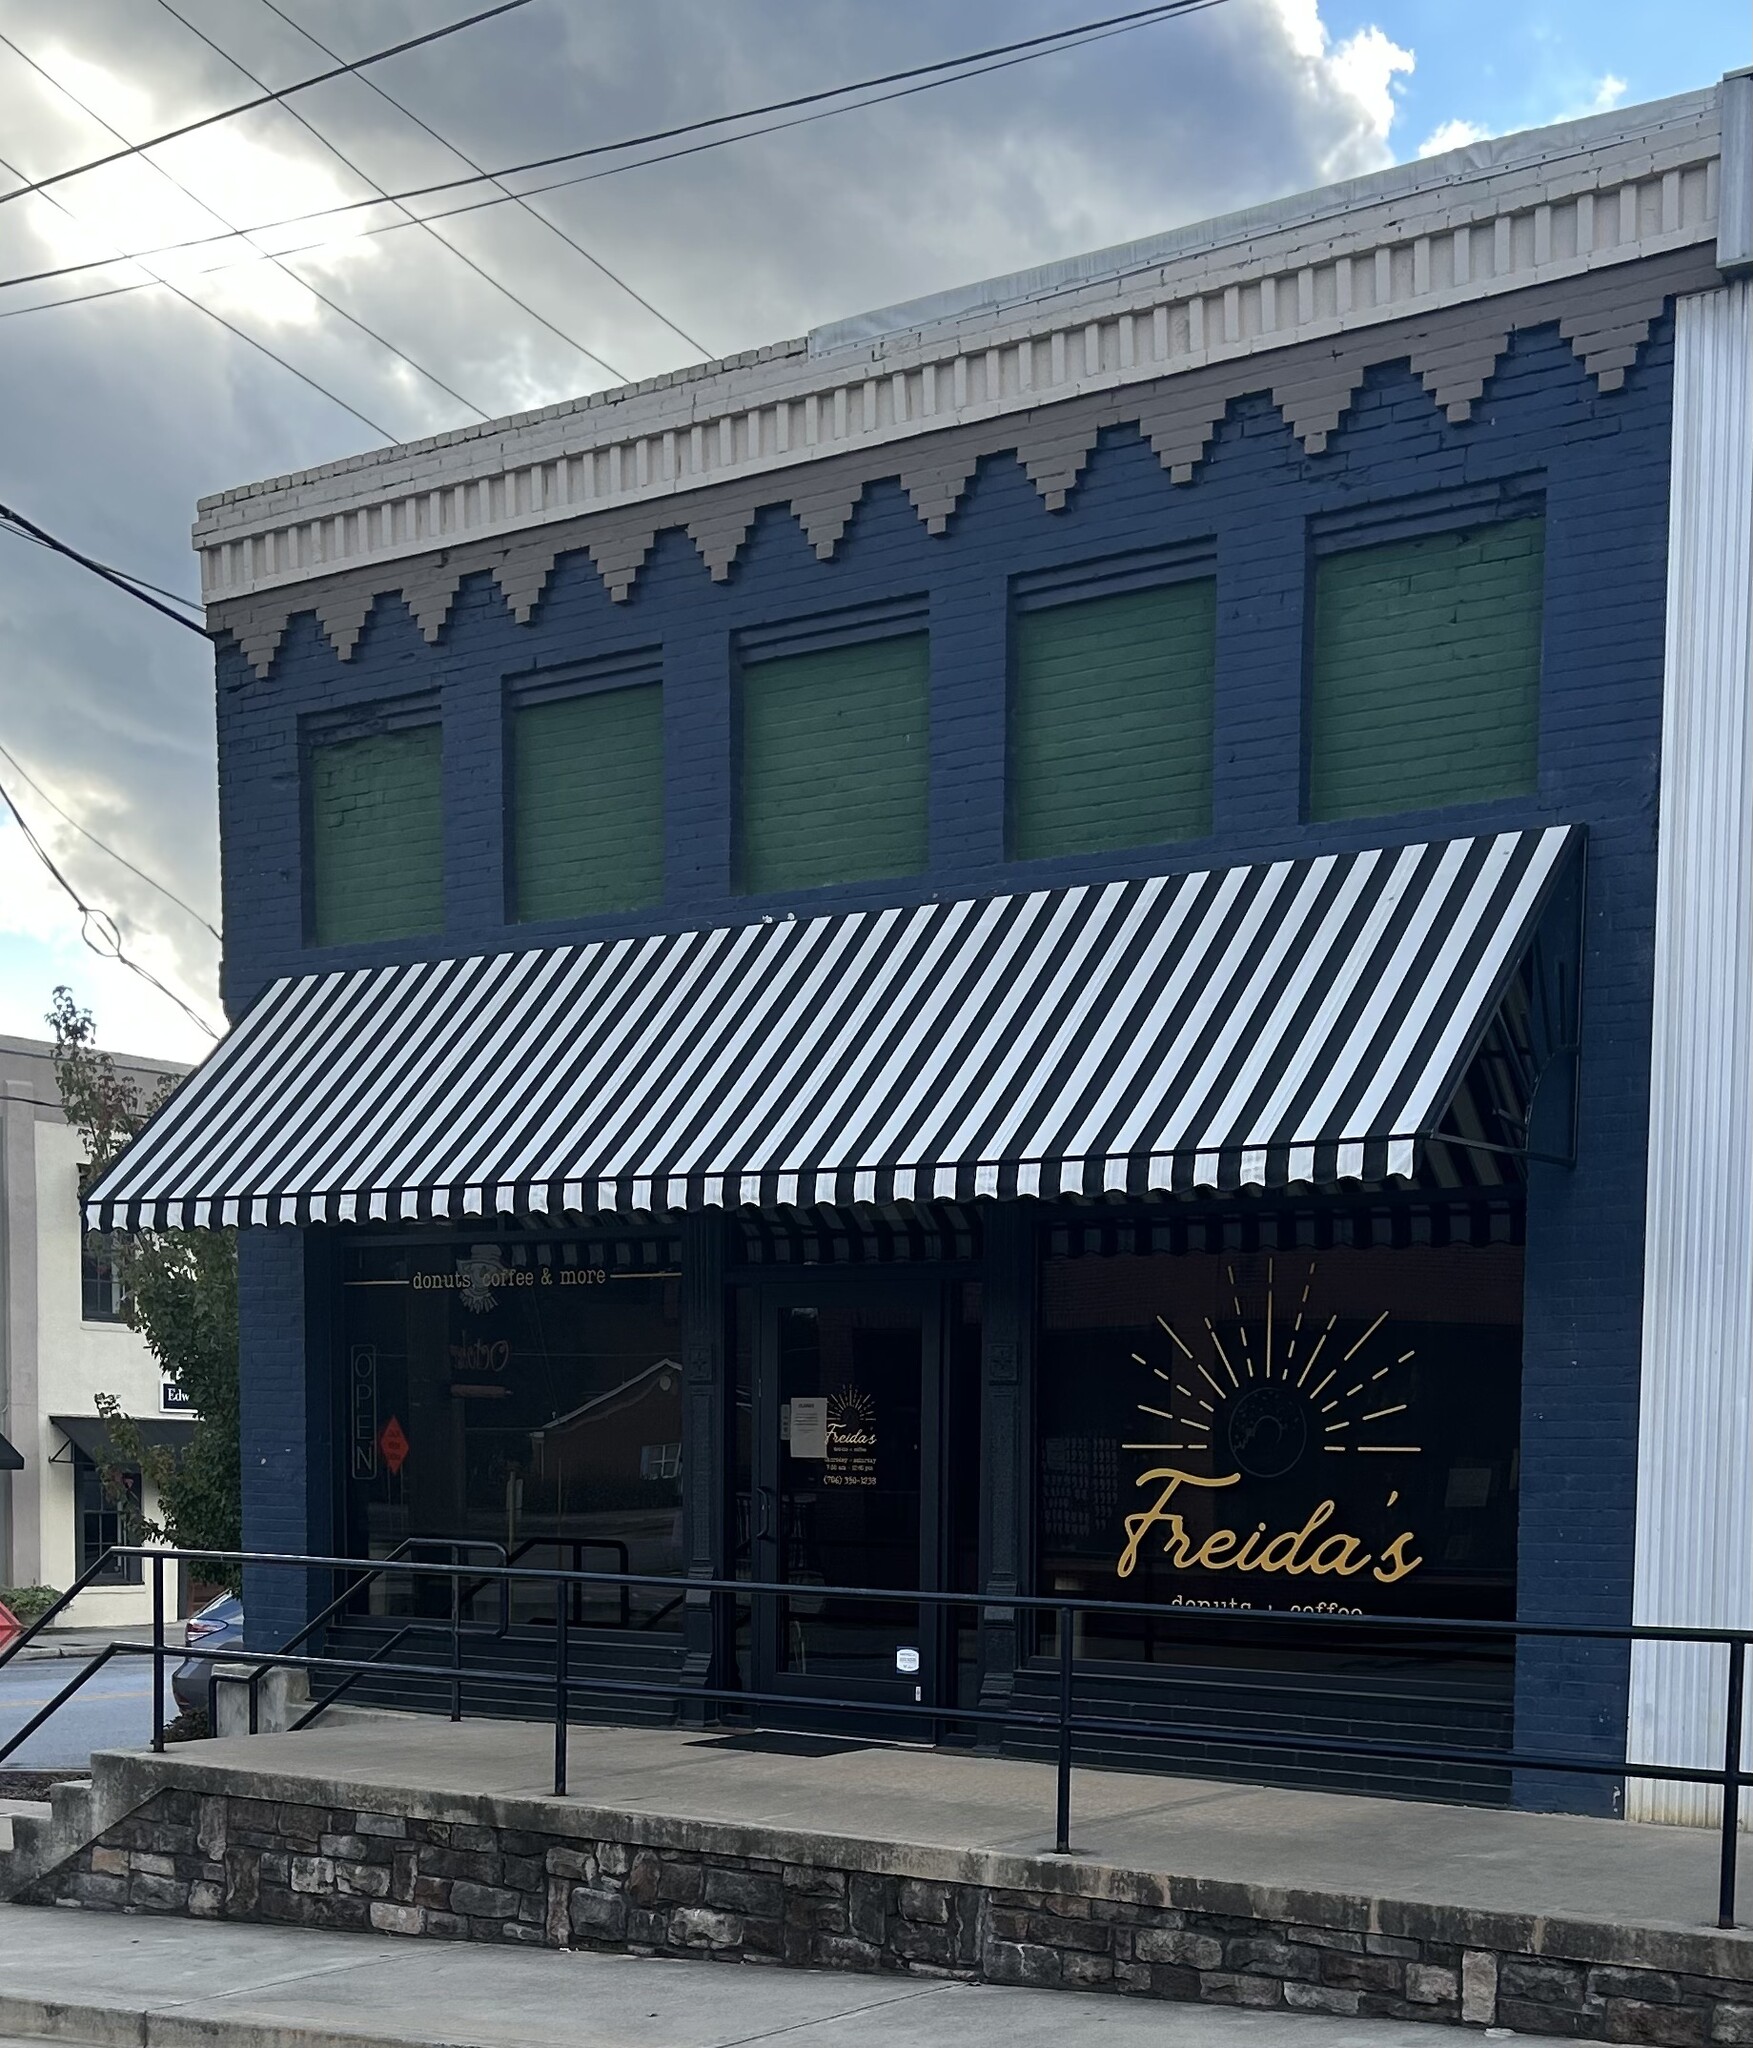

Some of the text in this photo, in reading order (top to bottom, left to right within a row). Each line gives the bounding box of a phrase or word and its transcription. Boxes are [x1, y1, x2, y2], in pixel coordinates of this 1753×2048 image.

[483, 1268, 534, 1288] coffee
[540, 1267, 553, 1287] &
[559, 1268, 607, 1286] more
[355, 1353, 373, 1470] OPEN
[824, 1423, 877, 1445] Freida's
[1117, 1468, 1423, 1583] Freida's
